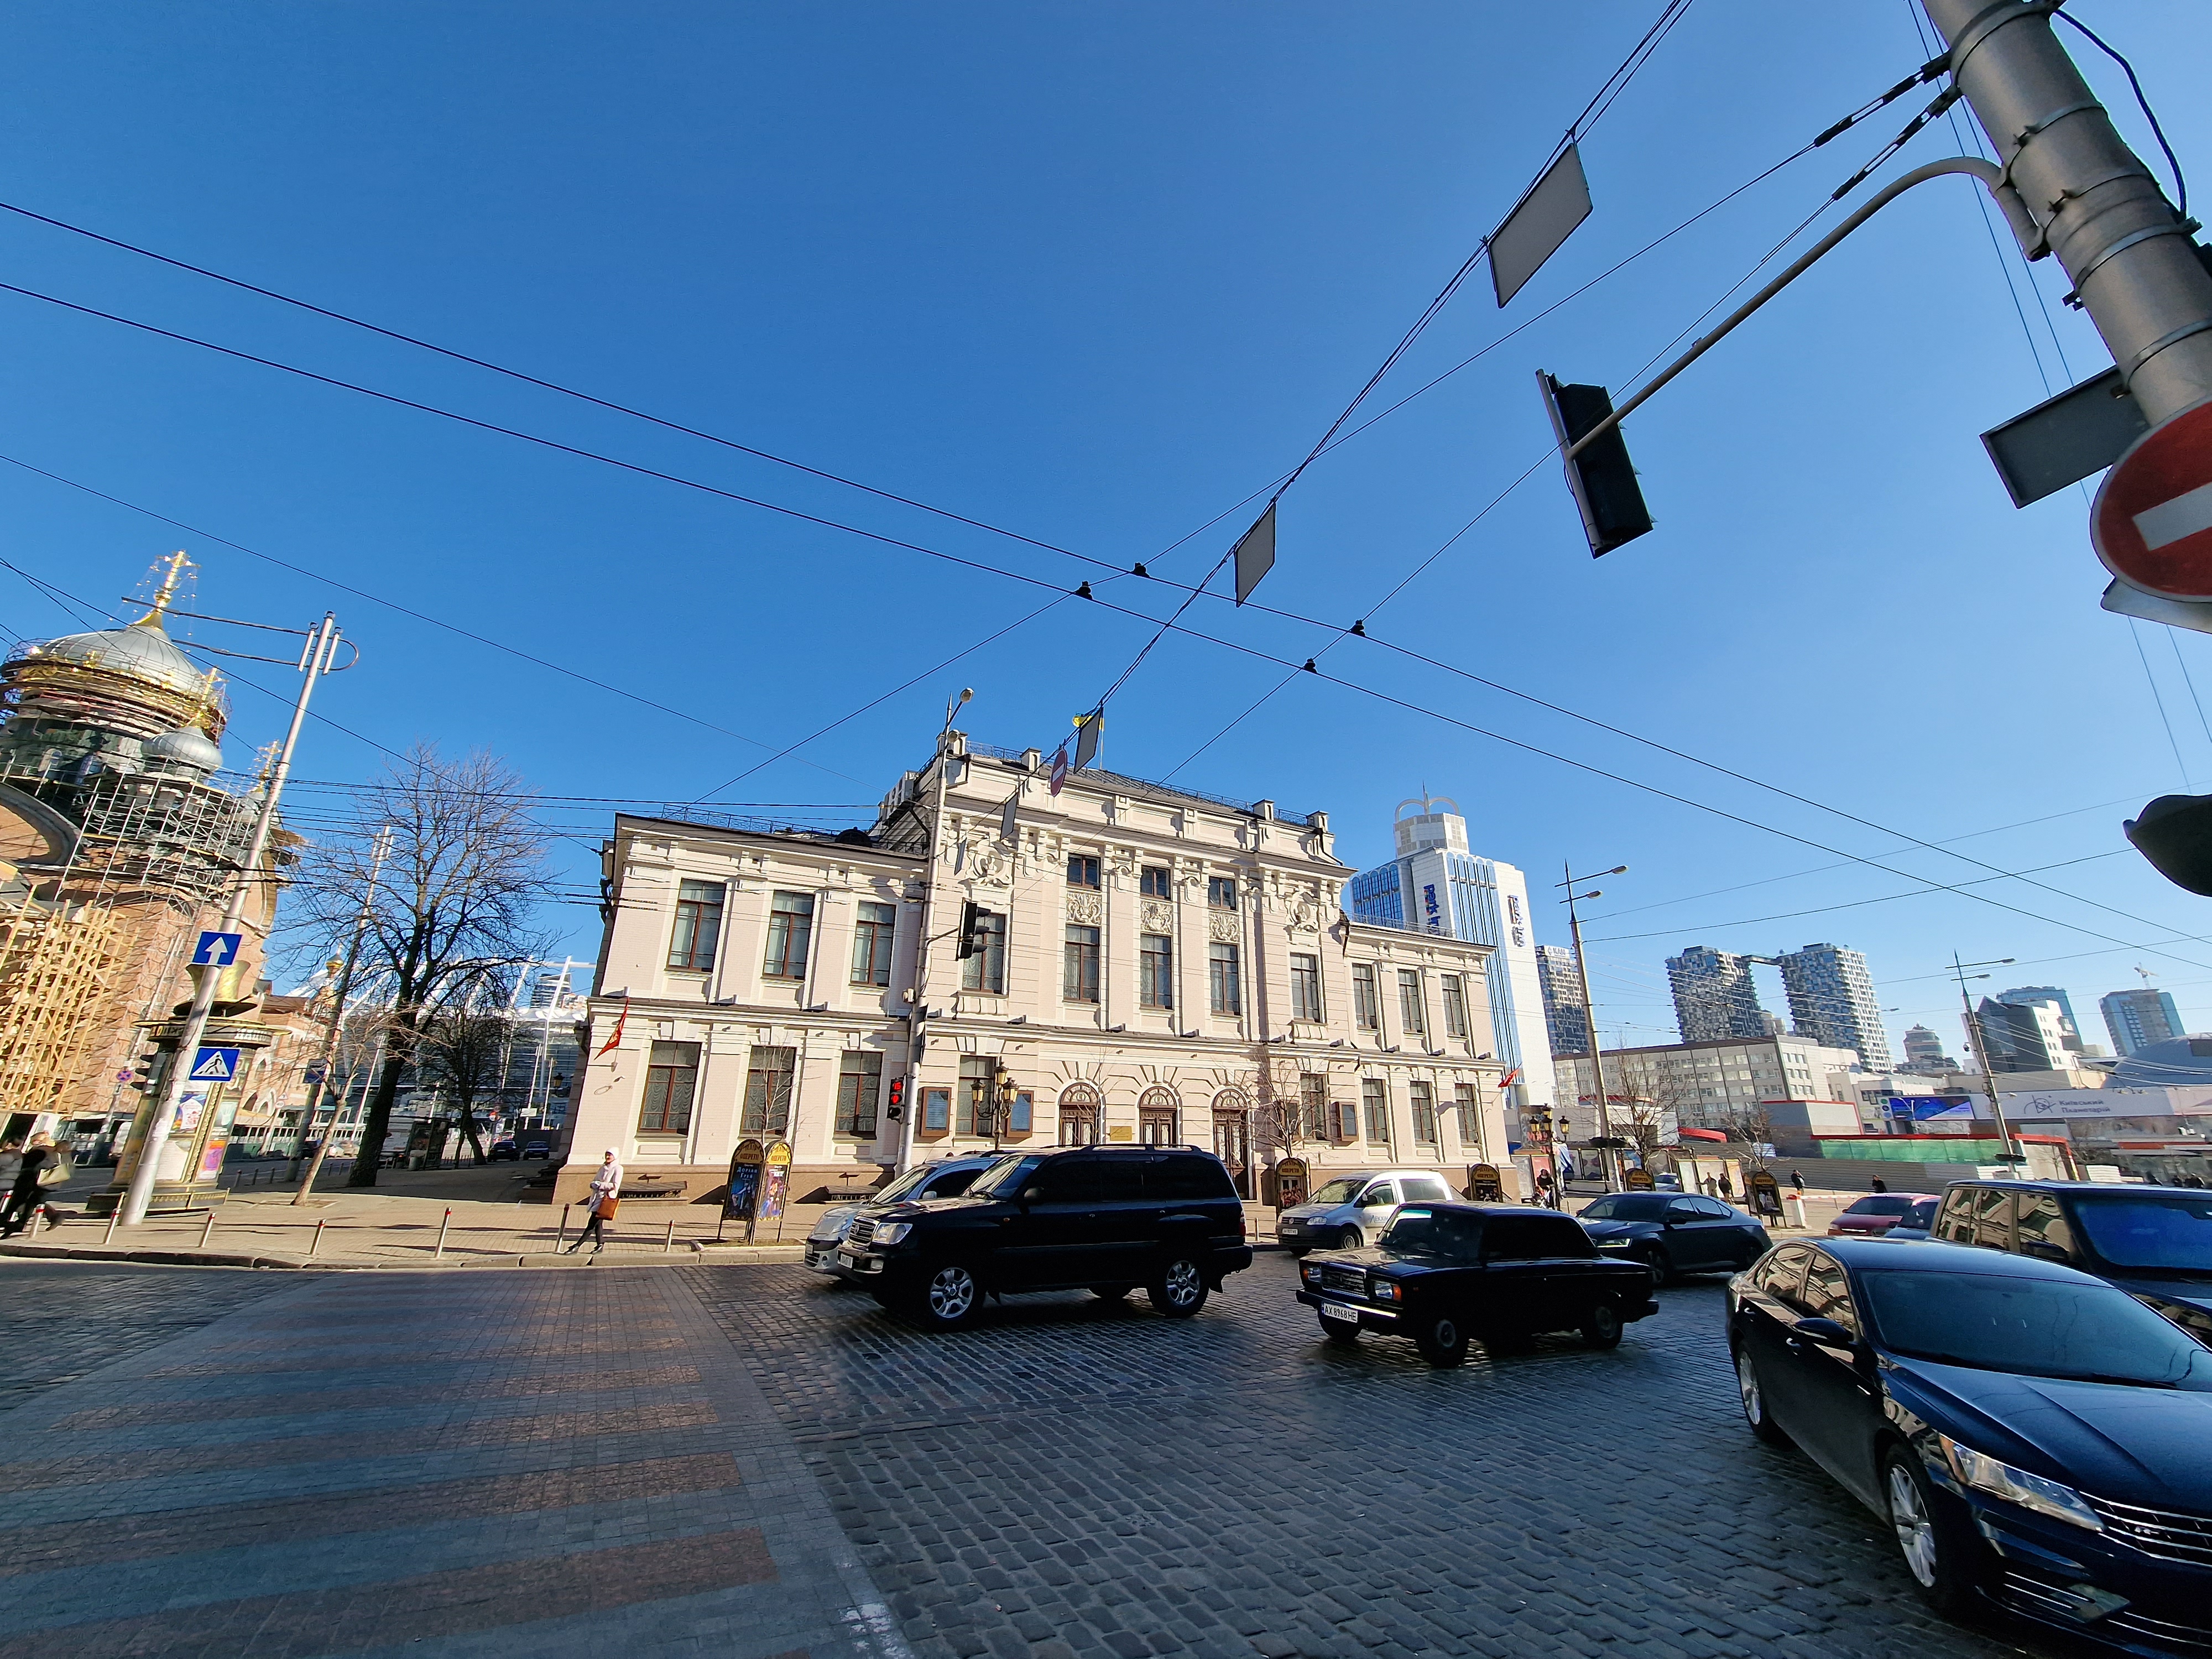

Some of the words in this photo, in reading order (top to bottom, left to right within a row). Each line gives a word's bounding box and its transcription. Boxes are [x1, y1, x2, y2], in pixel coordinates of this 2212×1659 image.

[1423, 884, 1439, 915] park
[1507, 895, 1524, 925] park
[1325, 1305, 1333, 1316] AX
[1348, 1311, 1357, 1321] HE
